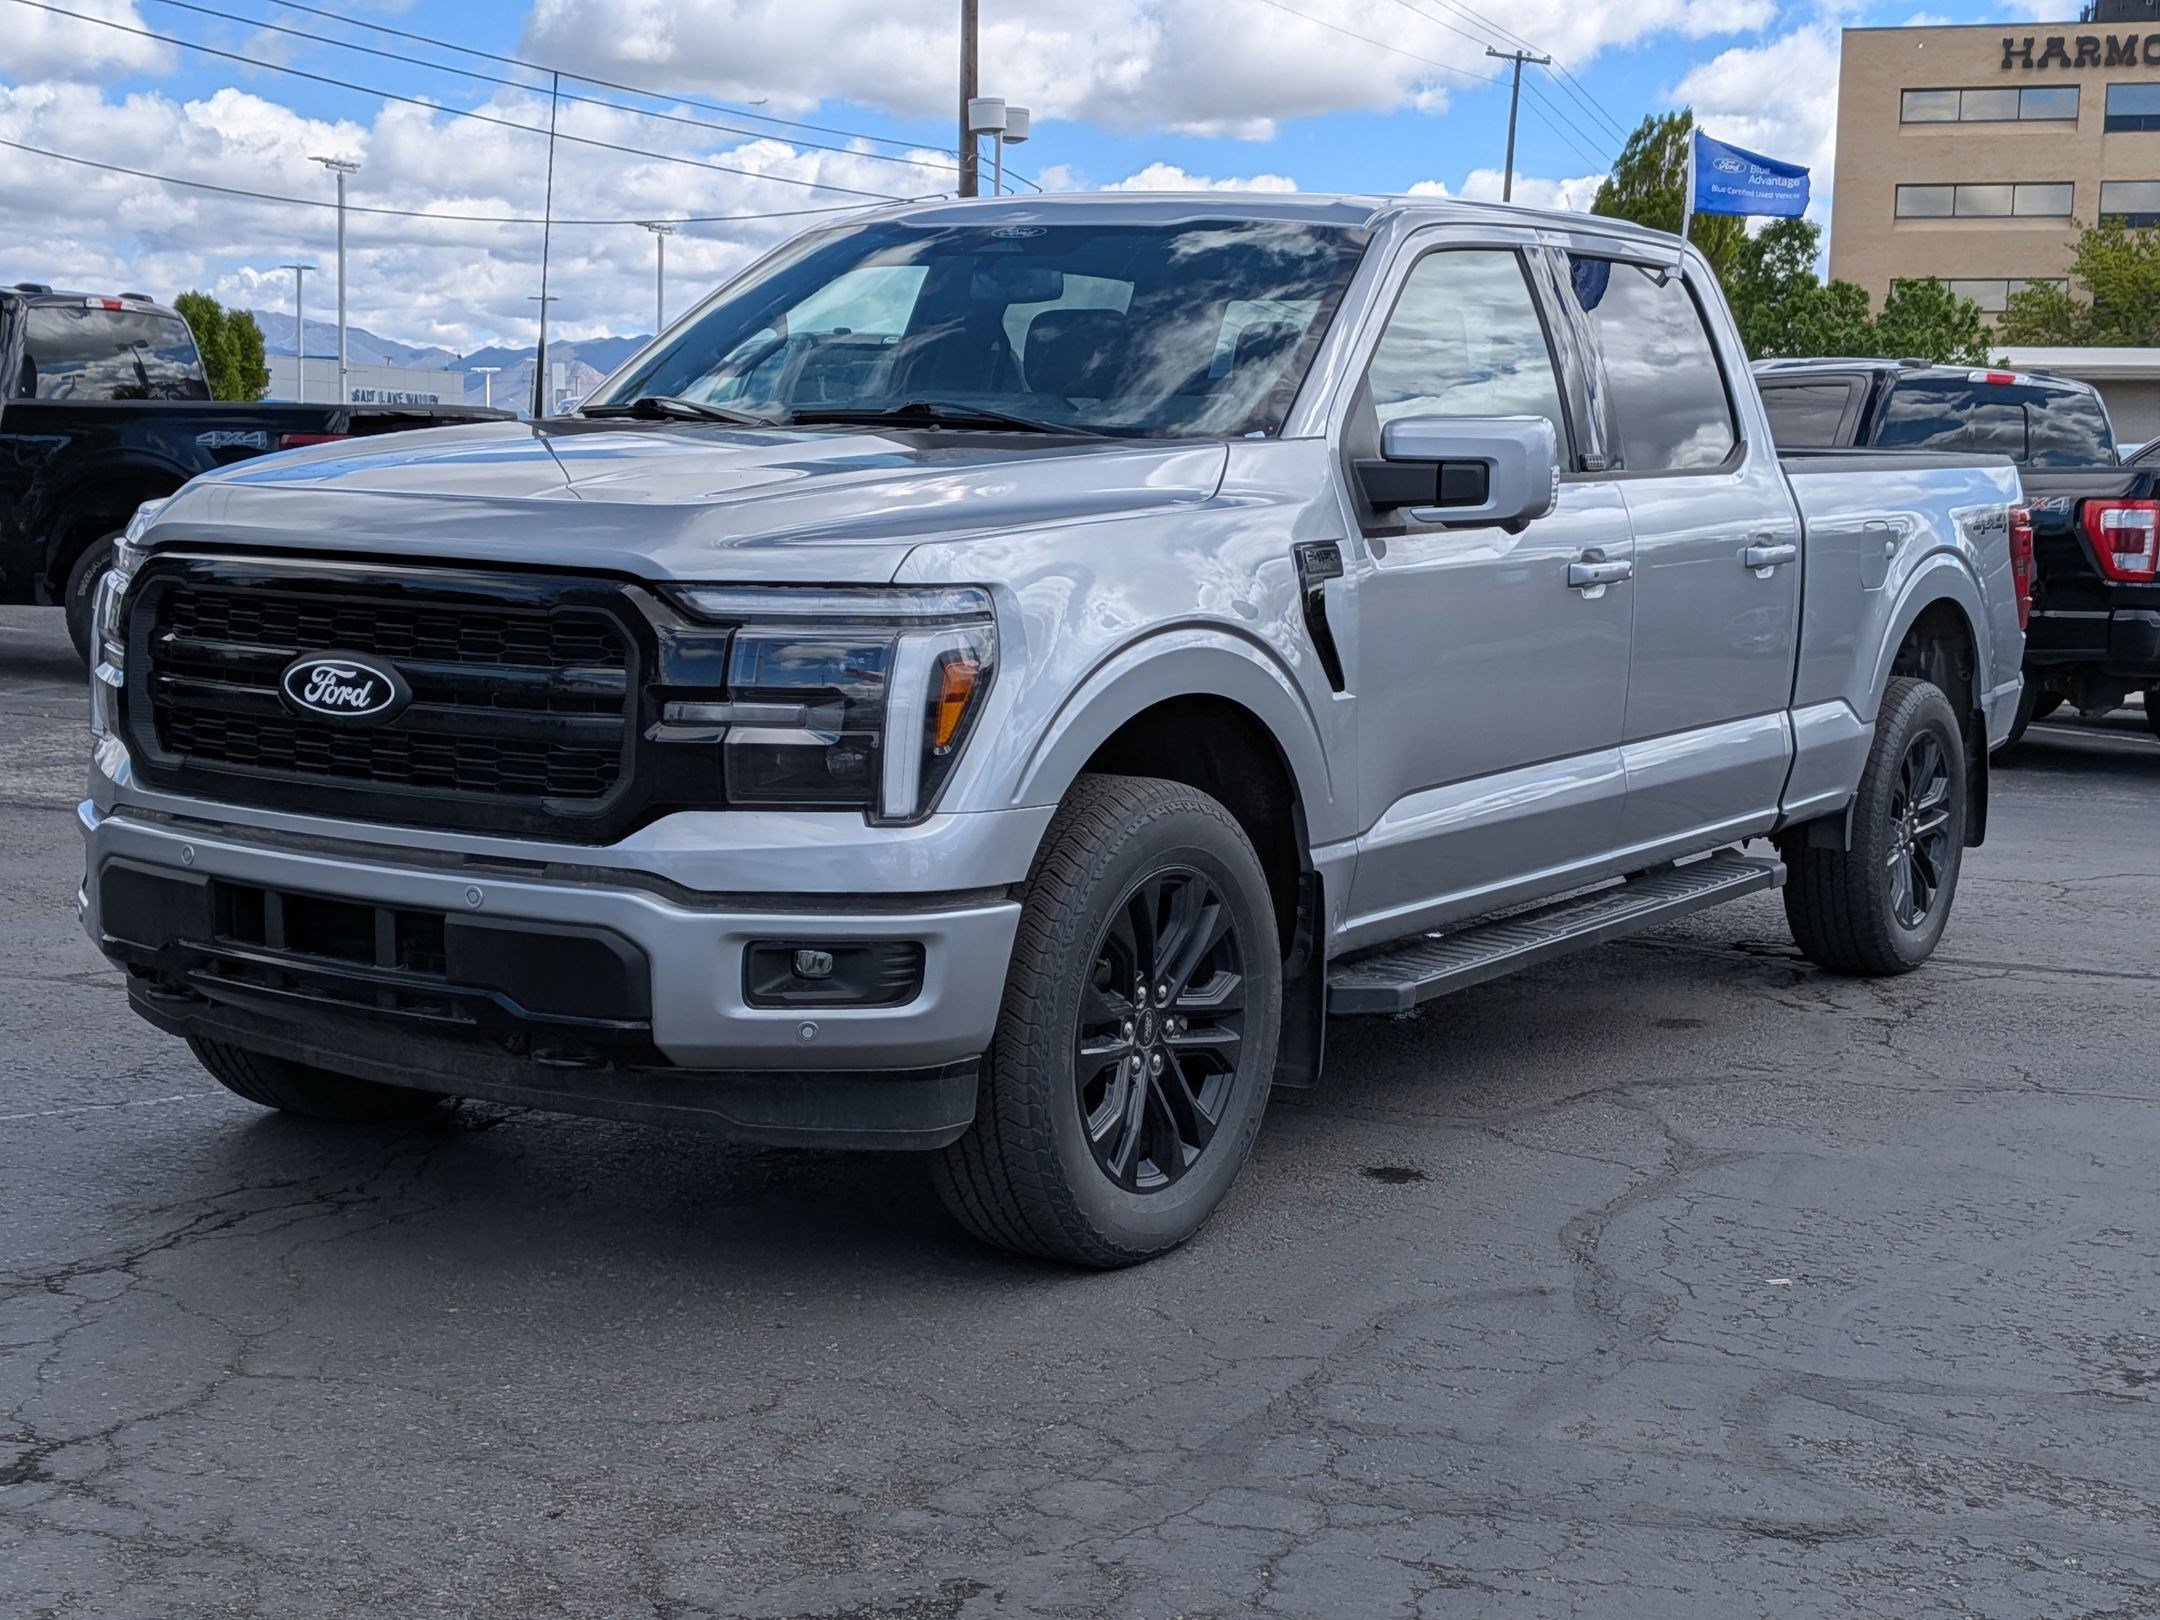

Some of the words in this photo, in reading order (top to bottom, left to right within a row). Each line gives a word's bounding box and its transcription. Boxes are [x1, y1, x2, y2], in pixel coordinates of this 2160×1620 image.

[1718, 160, 1741, 172] Ford
[1748, 174, 1800, 188] Advantage
[304, 666, 373, 708] Ford
